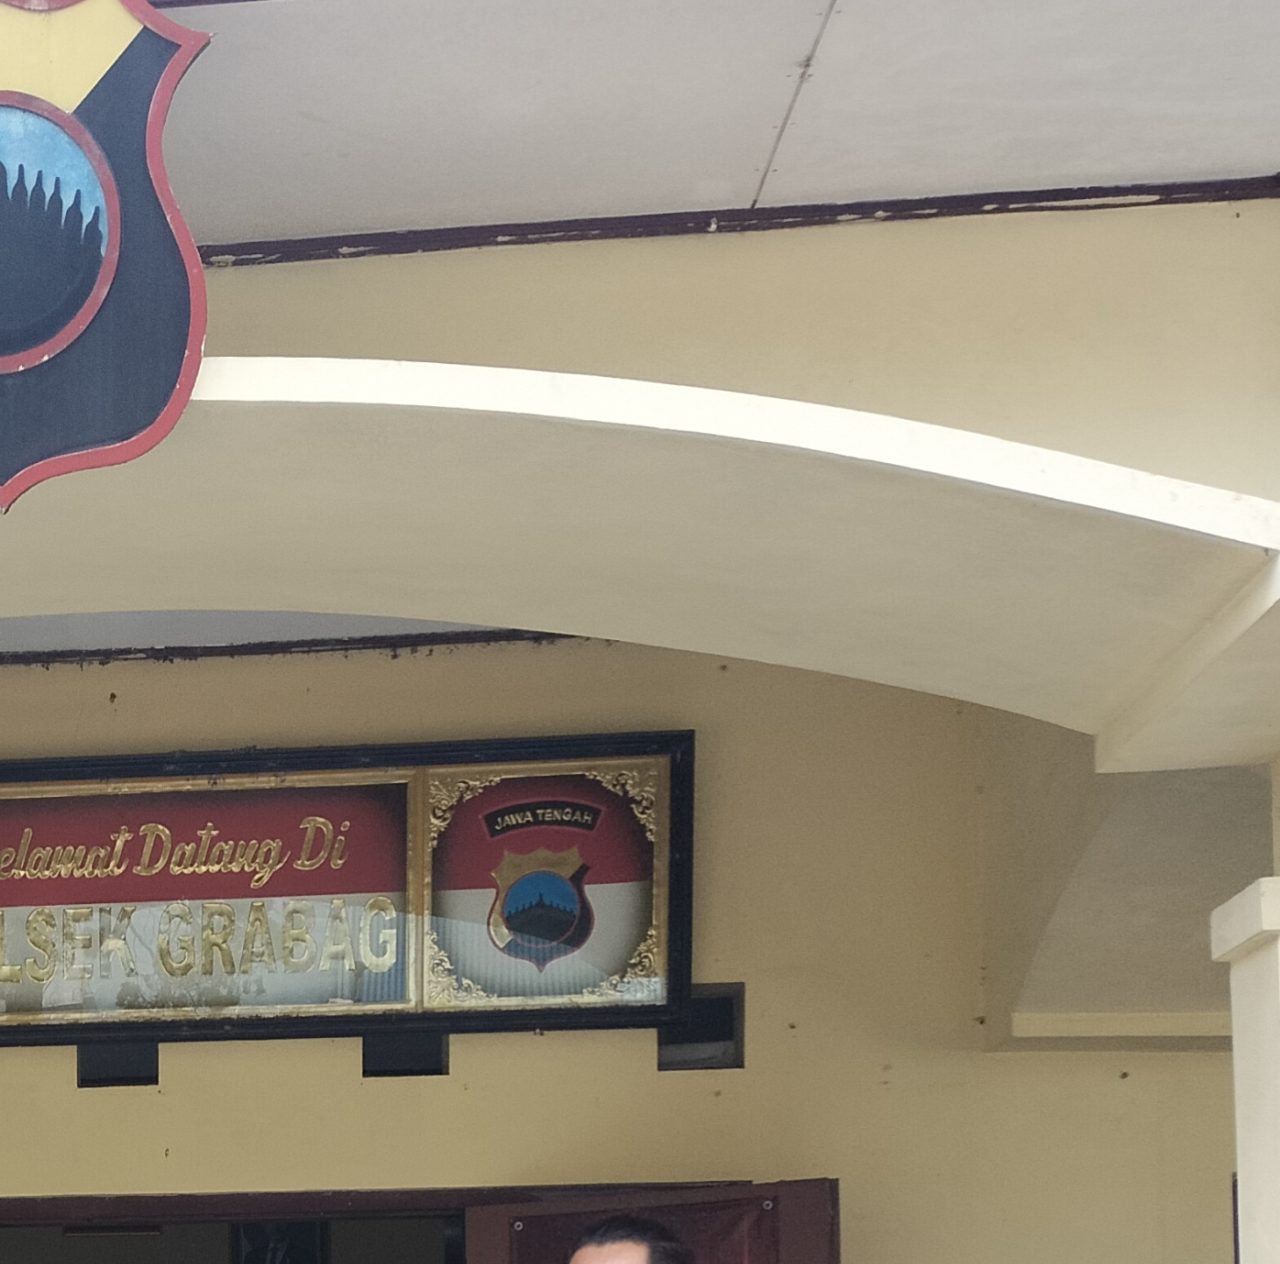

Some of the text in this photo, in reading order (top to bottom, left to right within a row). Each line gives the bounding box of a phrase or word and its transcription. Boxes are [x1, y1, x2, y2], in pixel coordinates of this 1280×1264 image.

[132, 822, 291, 889] Datang
[293, 816, 351, 871] Di
[494, 808, 593, 830] JAWA TENGAH
[158, 896, 398, 977] GRABAG
